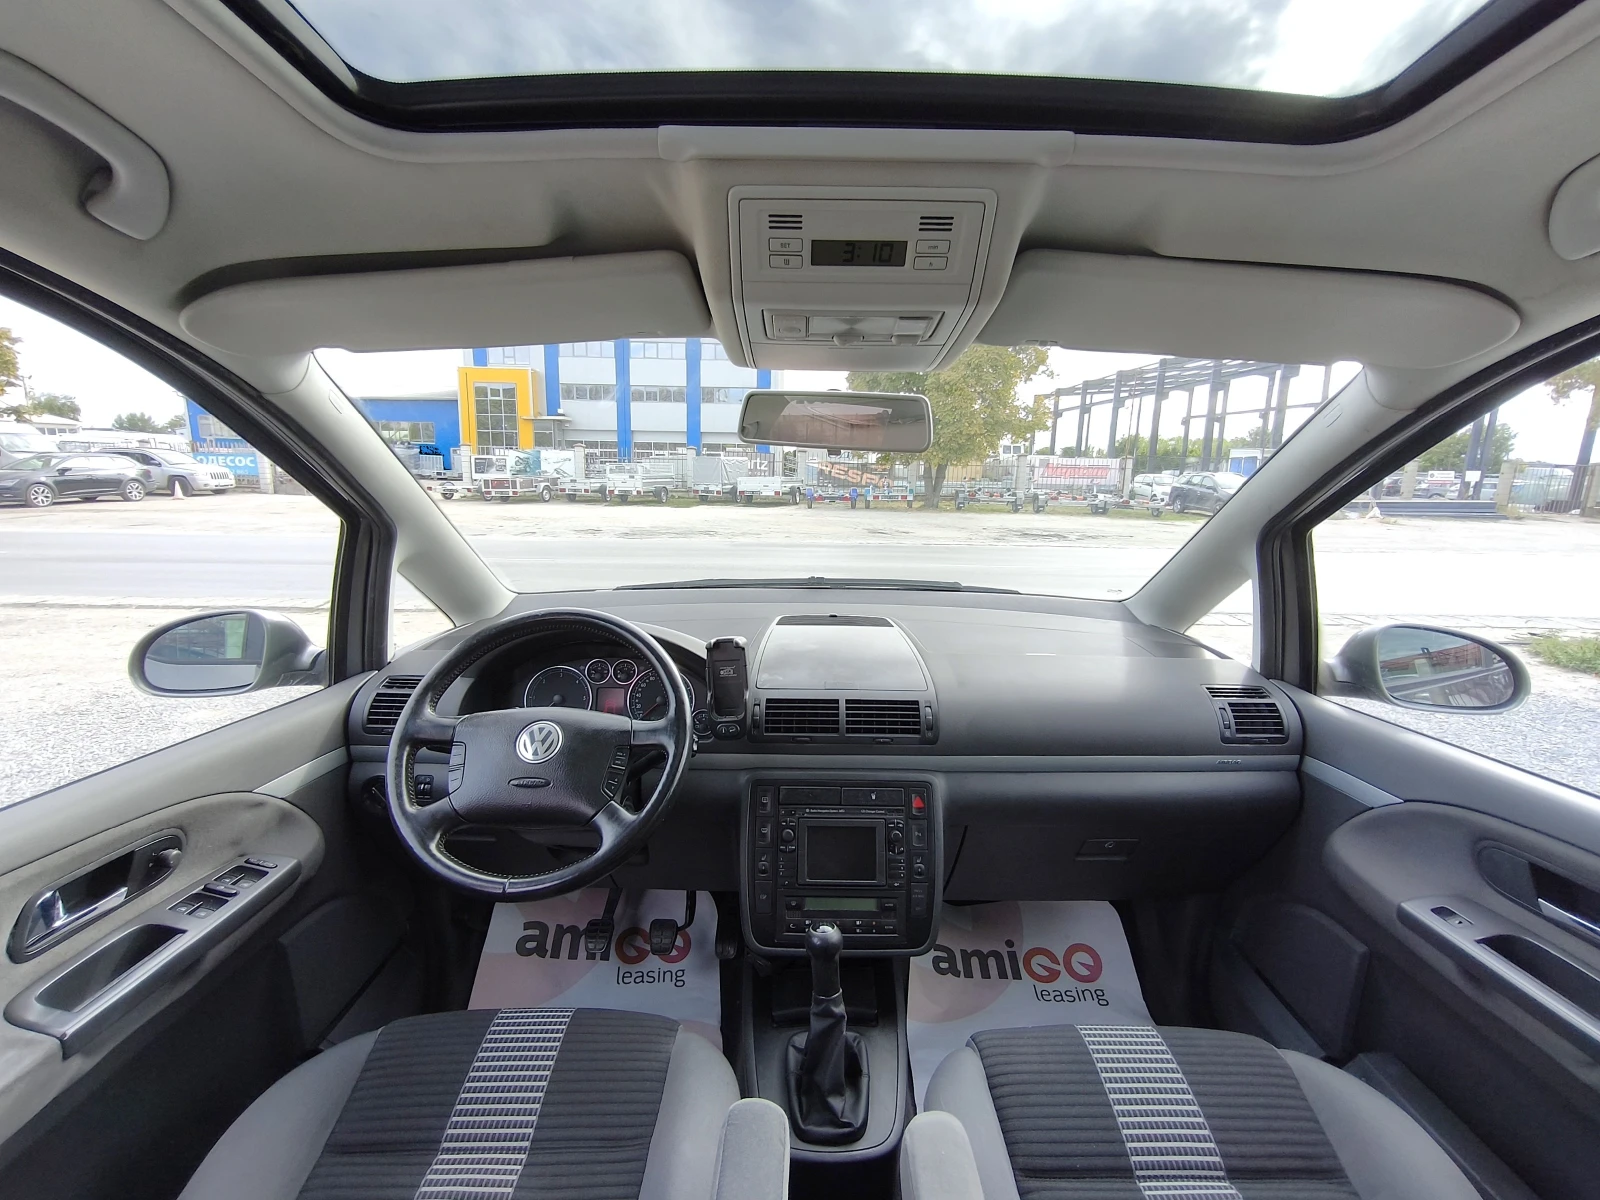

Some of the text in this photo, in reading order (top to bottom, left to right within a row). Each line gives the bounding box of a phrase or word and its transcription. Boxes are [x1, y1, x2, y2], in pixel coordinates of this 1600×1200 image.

[842, 242, 894, 264] 3:10
[616, 966, 686, 988] leasing
[1033, 984, 1110, 1007] leasing
